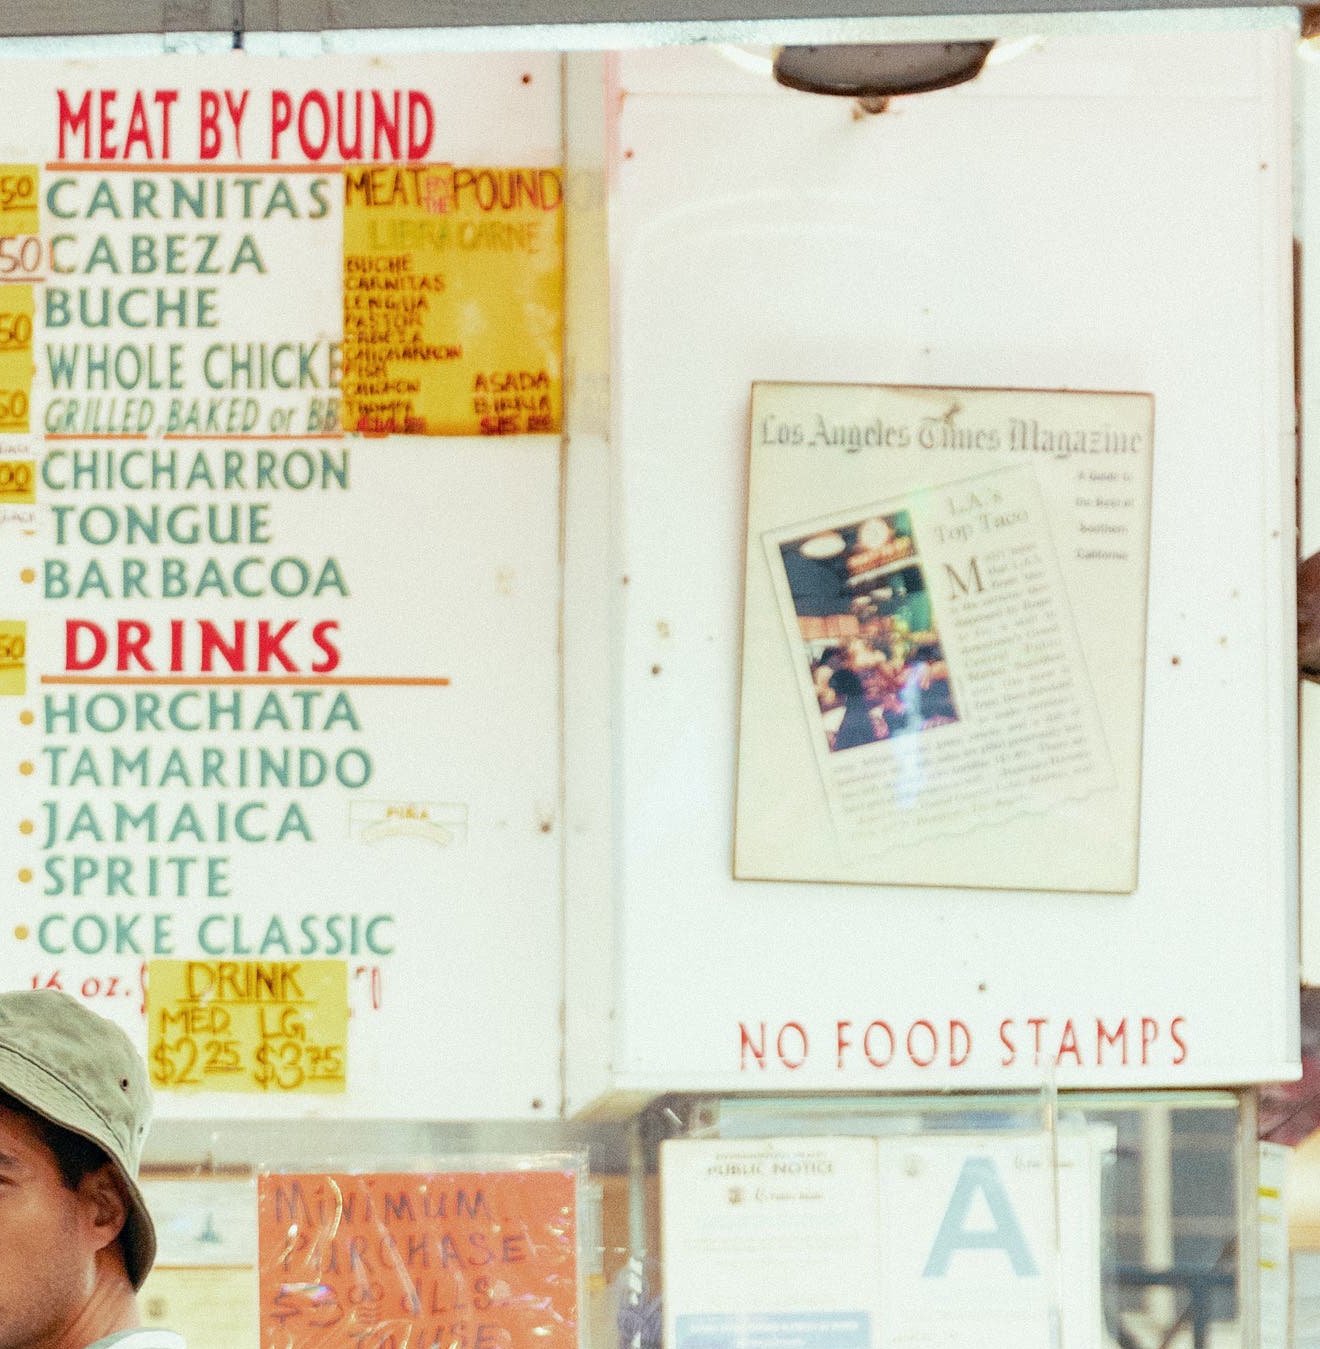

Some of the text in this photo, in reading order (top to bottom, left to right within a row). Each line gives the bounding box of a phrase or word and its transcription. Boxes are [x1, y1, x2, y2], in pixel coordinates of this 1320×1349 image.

[56, 89, 436, 160] MEAT BY POUND
[46, 177, 334, 220] CARNITAS
[345, 168, 428, 207] MEAT
[453, 169, 563, 212] POUND
[49, 233, 269, 275] CABEZA
[44, 287, 220, 329] BUCHE
[46, 341, 343, 391] WHOLE CHICKE
[164, 397, 261, 434] BAKED
[269, 406, 296, 433] or
[307, 397, 343, 433] BB
[760, 413, 805, 447] Los
[809, 412, 912, 454] Angeles
[1008, 418, 1143, 459] Magazine
[41, 448, 352, 491] CHICHARRON
[50, 503, 273, 546] TONGUE
[42, 557, 352, 600] BARBACOA
[64, 618, 342, 674] DRINKS
[43, 689, 361, 734] HORCHATA
[42, 745, 375, 789] TAMARINDO
[41, 800, 316, 850] JAMAICA
[43, 855, 232, 899] SPRITE
[37, 912, 396, 958] COKE CLASSIC
[185, 961, 306, 1000] DRINK
[160, 1008, 232, 1037] MED
[739, 1015, 1192, 1070] NO FOOD STAMPS
[921, 1156, 1041, 1278] A
